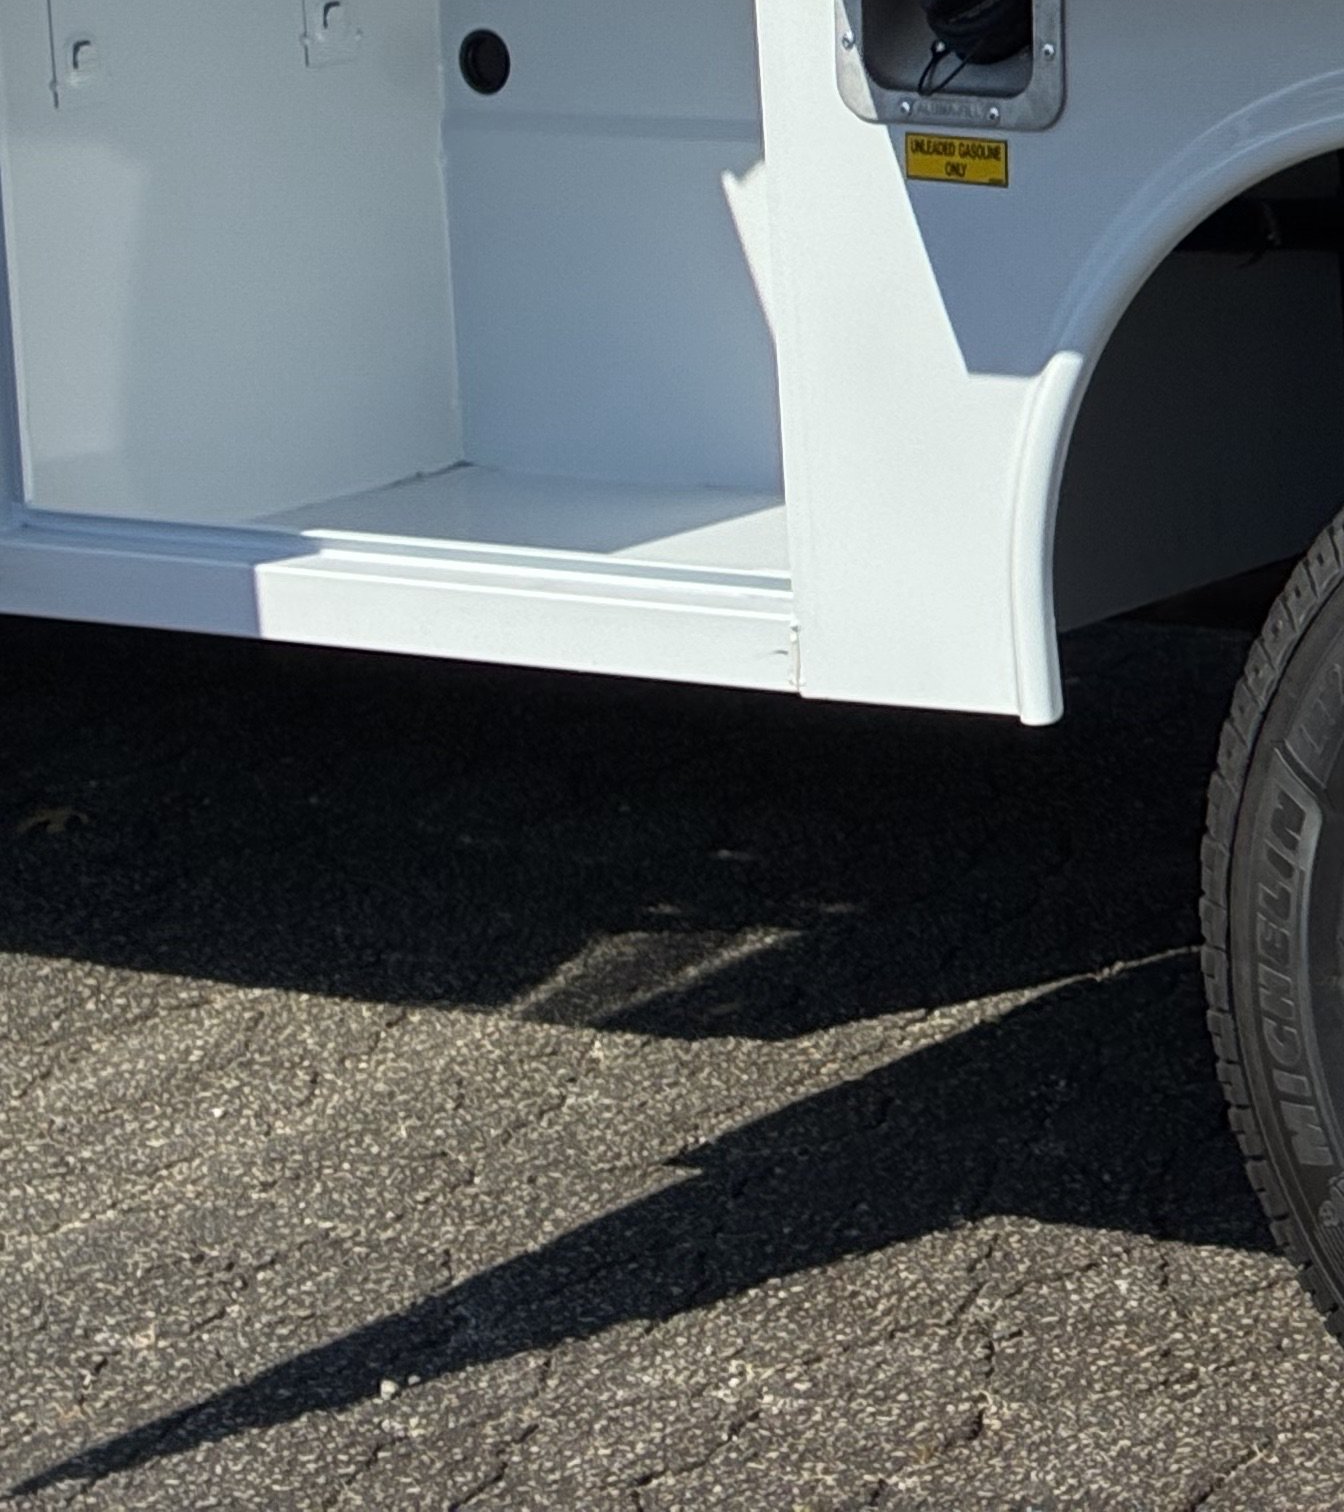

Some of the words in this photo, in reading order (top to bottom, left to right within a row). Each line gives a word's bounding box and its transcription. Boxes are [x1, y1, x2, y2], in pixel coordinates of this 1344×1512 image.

[911, 139, 956, 157] UNLEADED
[958, 142, 1002, 161] GASOLINE
[945, 161, 968, 177] ONLY
[1255, 789, 1334, 1167] MICHELIN
